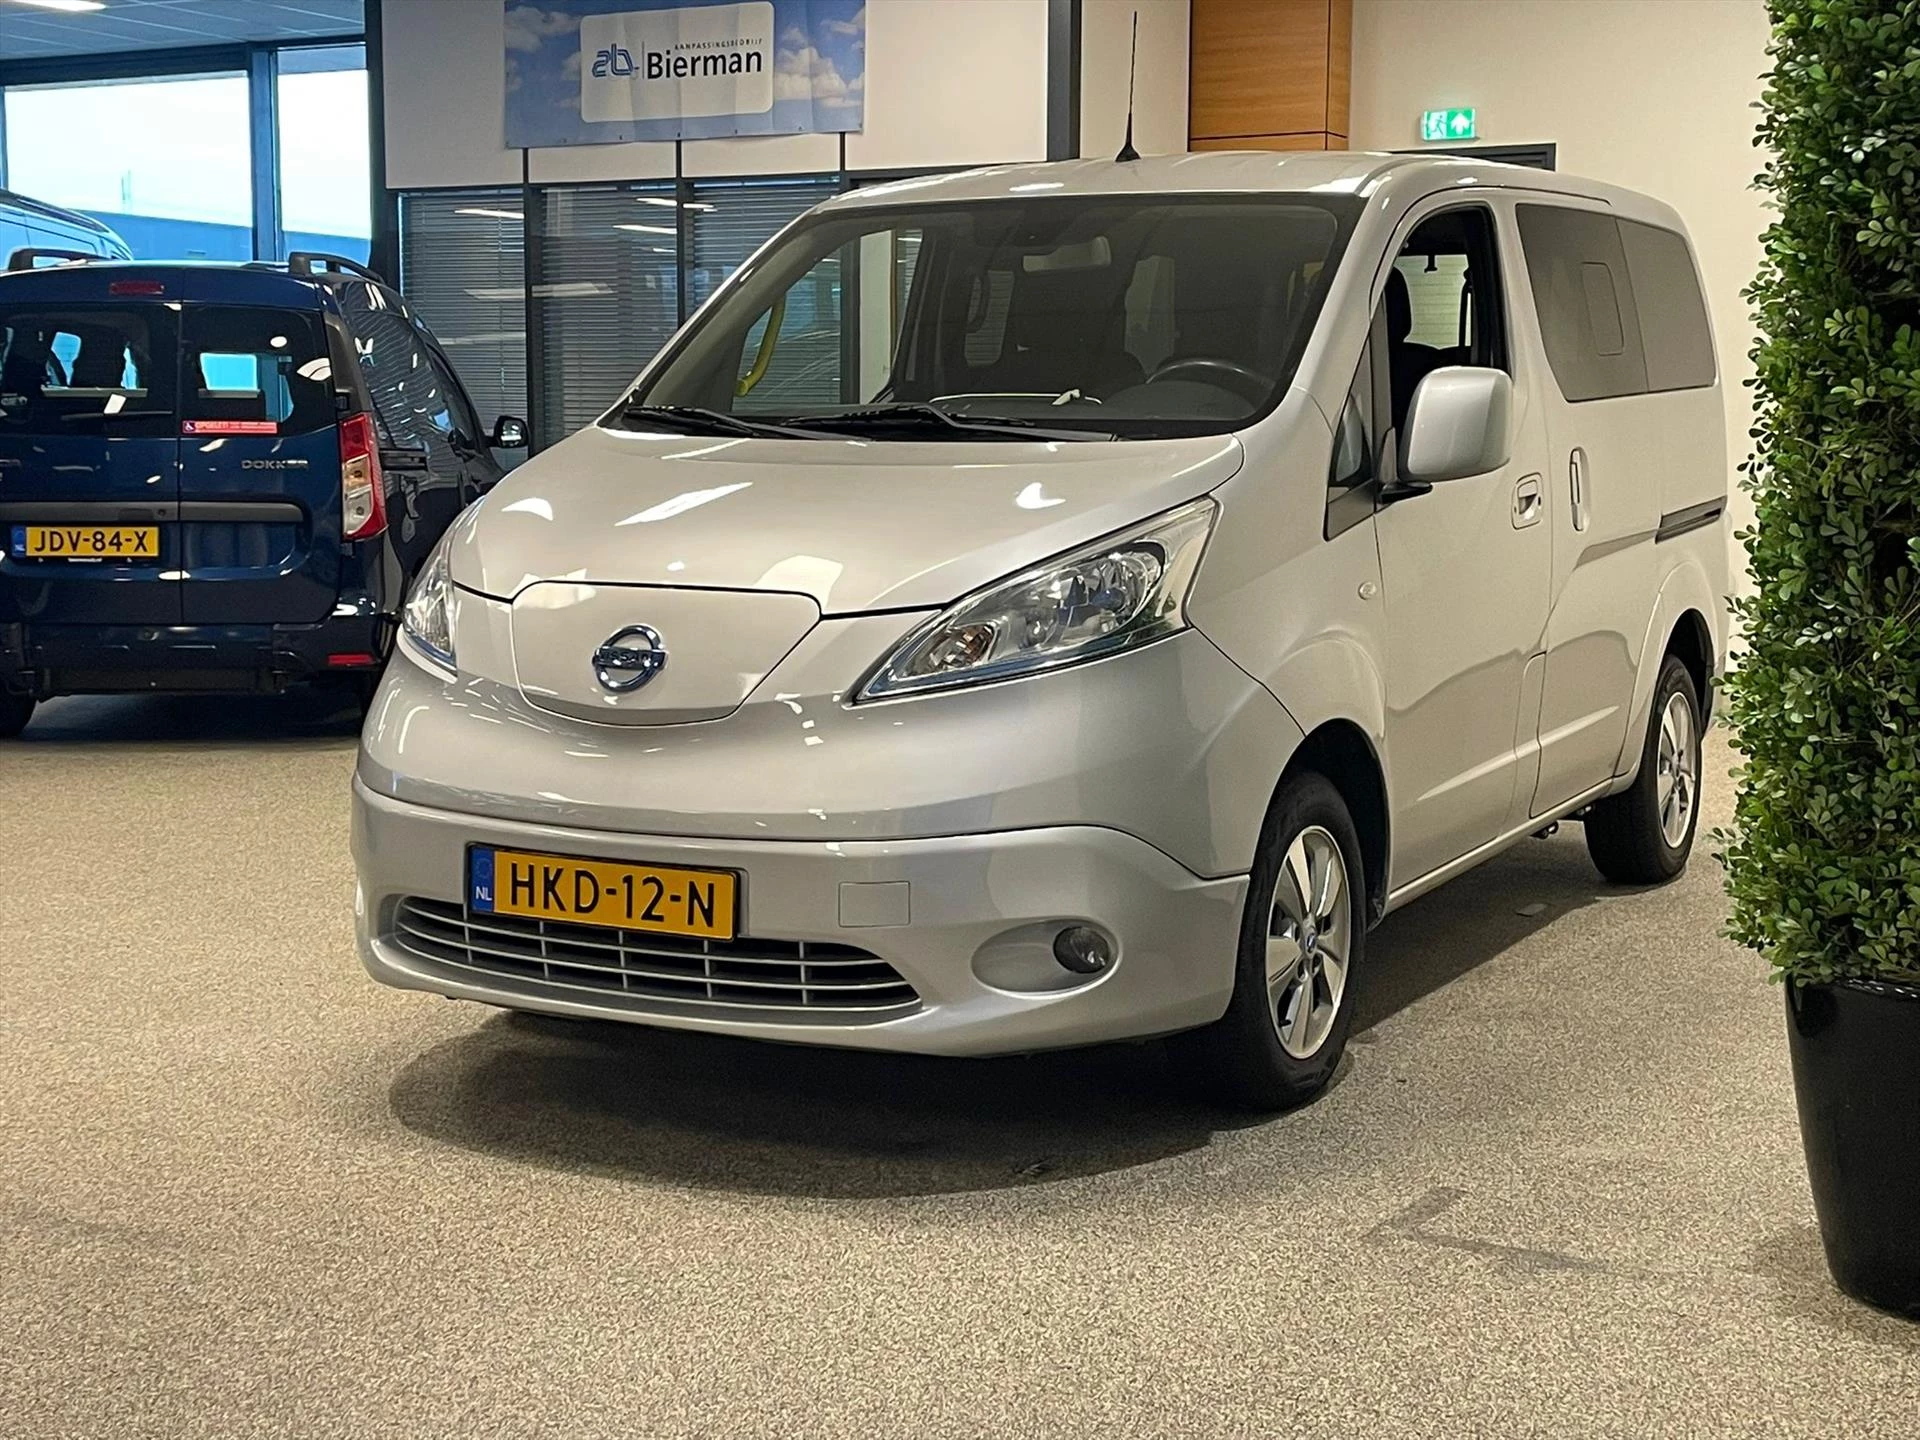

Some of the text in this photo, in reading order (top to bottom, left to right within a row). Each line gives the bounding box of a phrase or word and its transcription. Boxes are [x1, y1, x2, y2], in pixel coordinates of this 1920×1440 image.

[648, 50, 762, 79] Bierman
[34, 531, 148, 552] JDV-84-X
[475, 886, 492, 901] NL
[510, 862, 715, 928] HKD-12-N
